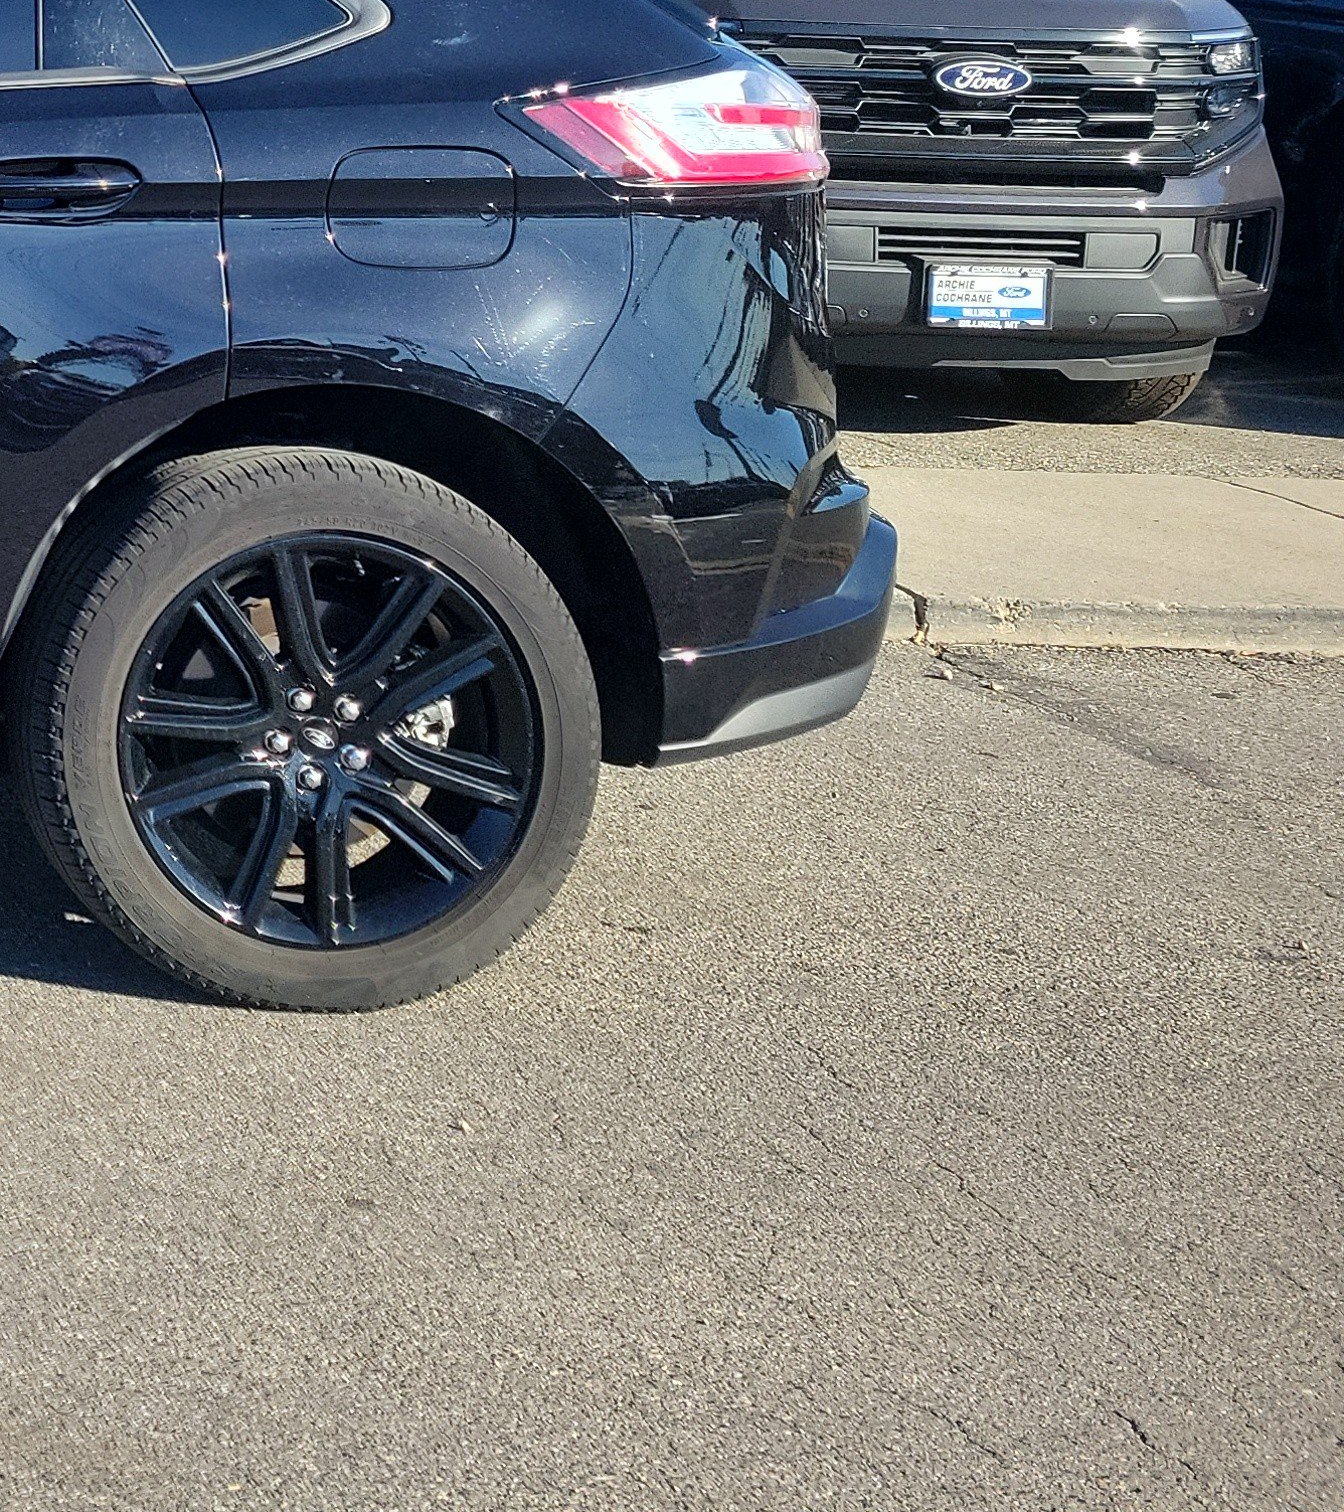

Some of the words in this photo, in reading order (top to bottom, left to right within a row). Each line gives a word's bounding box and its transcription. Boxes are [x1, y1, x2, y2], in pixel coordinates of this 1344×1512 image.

[954, 66, 1016, 90] Ford
[937, 280, 975, 290] ARCHIE
[935, 293, 992, 303] COCHRANE
